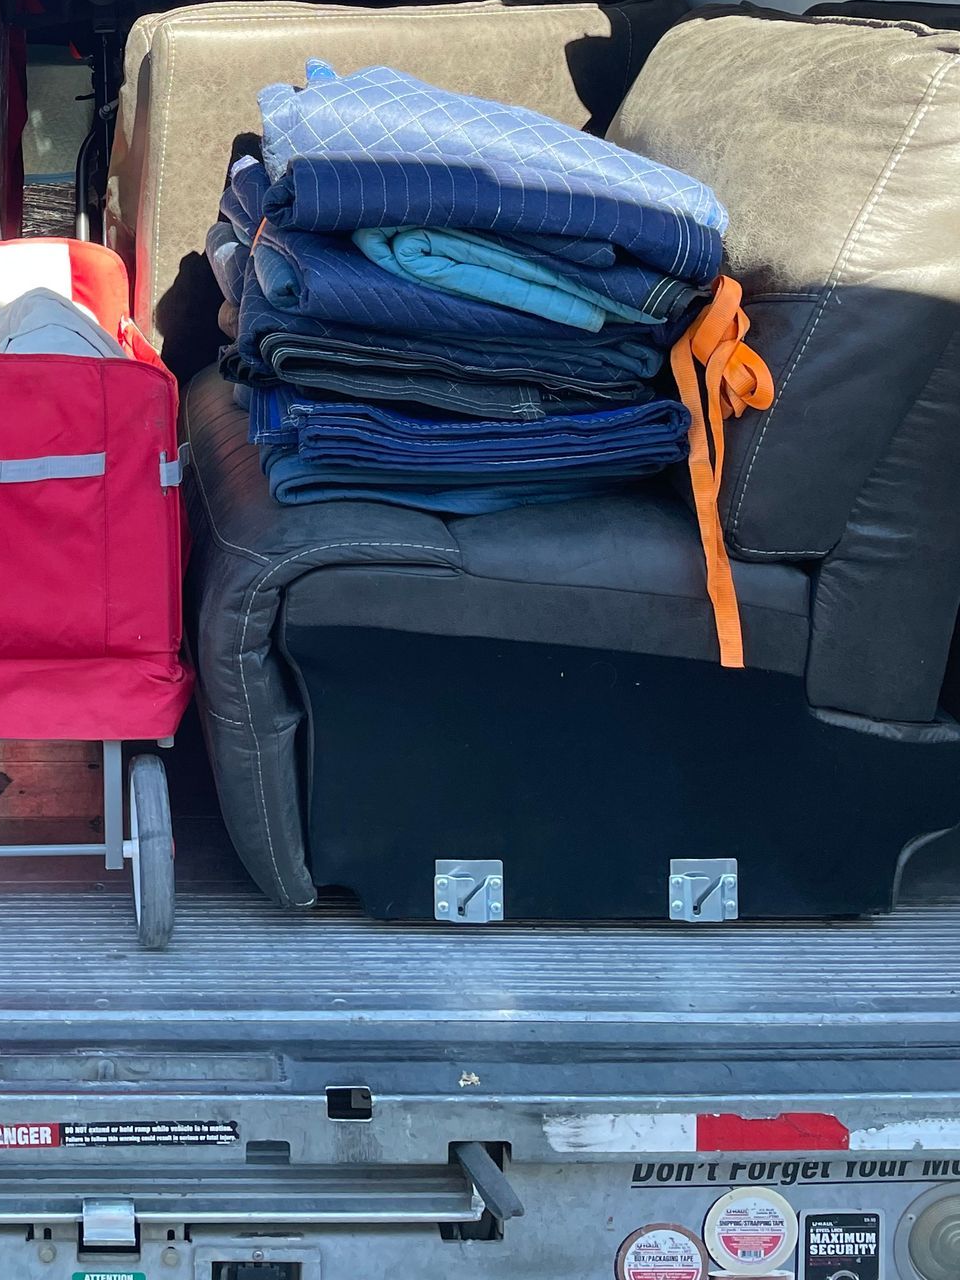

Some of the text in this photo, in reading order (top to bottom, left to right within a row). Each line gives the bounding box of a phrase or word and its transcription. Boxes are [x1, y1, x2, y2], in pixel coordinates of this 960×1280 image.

[64, 1126, 74, 1134] DO
[74, 1126, 87, 1134] NOT
[134, 1126, 151, 1134] ramp
[631, 1161, 719, 1181] Don't
[729, 1161, 830, 1185] Forget
[810, 1232, 876, 1244] MAXIMUM
[809, 1244, 876, 1255] SECURITY
